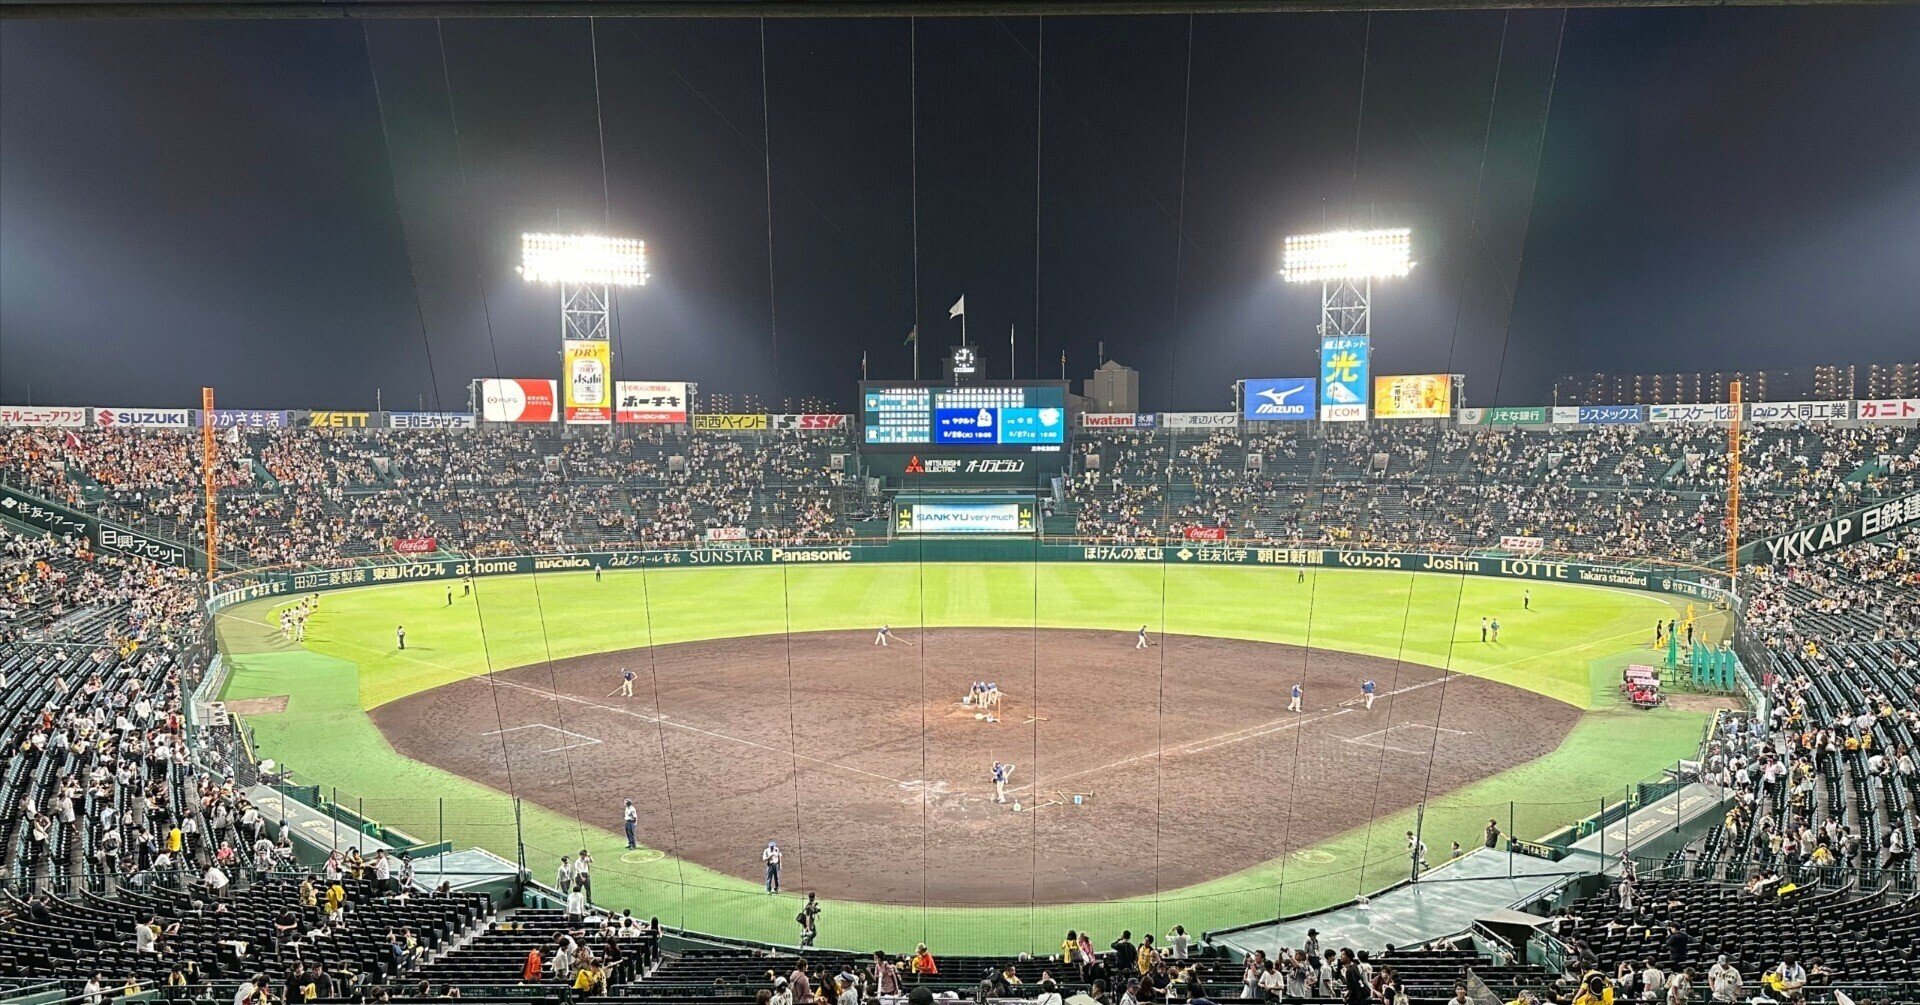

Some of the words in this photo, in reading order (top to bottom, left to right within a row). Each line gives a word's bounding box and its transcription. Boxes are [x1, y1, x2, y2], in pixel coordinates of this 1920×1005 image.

[1325, 351, 1364, 383] 光
[574, 373, 602, 384] Asahi
[622, 395, 680, 407] ホーチキ
[2, 411, 82, 422] テルニューアワジ
[118, 413, 184, 424] SUZUKI
[1580, 409, 1639, 420] シスメックス
[1781, 403, 1847, 419] 大同工業
[310, 412, 369, 427] ZETT
[694, 416, 765, 428] 関西ペイント
[801, 416, 844, 428] SSK
[1086, 415, 1133, 425] Iwatani
[17, 502, 86, 533] 住友ファーマ
[970, 514, 989, 522] very
[991, 513, 1014, 521] much
[102, 530, 183, 564] 日興アセット
[1766, 527, 1816, 561] YKK
[1817, 518, 1852, 550] AP
[689, 550, 764, 563] SUNSTAR
[772, 548, 851, 562] Panasonic
[1196, 549, 1247, 561] 住友化学
[1257, 549, 1324, 564] 朝日新聞
[1339, 552, 1401, 568] Kubota
[456, 564, 471, 575] at
[475, 559, 517, 574] home
[1423, 555, 1479, 571] Joshin
[1501, 560, 1568, 578] LOTTE
[373, 563, 446, 580] 東進ハイスクール
[1579, 569, 1608, 582] Takara
[1608, 573, 1647, 586] standard
